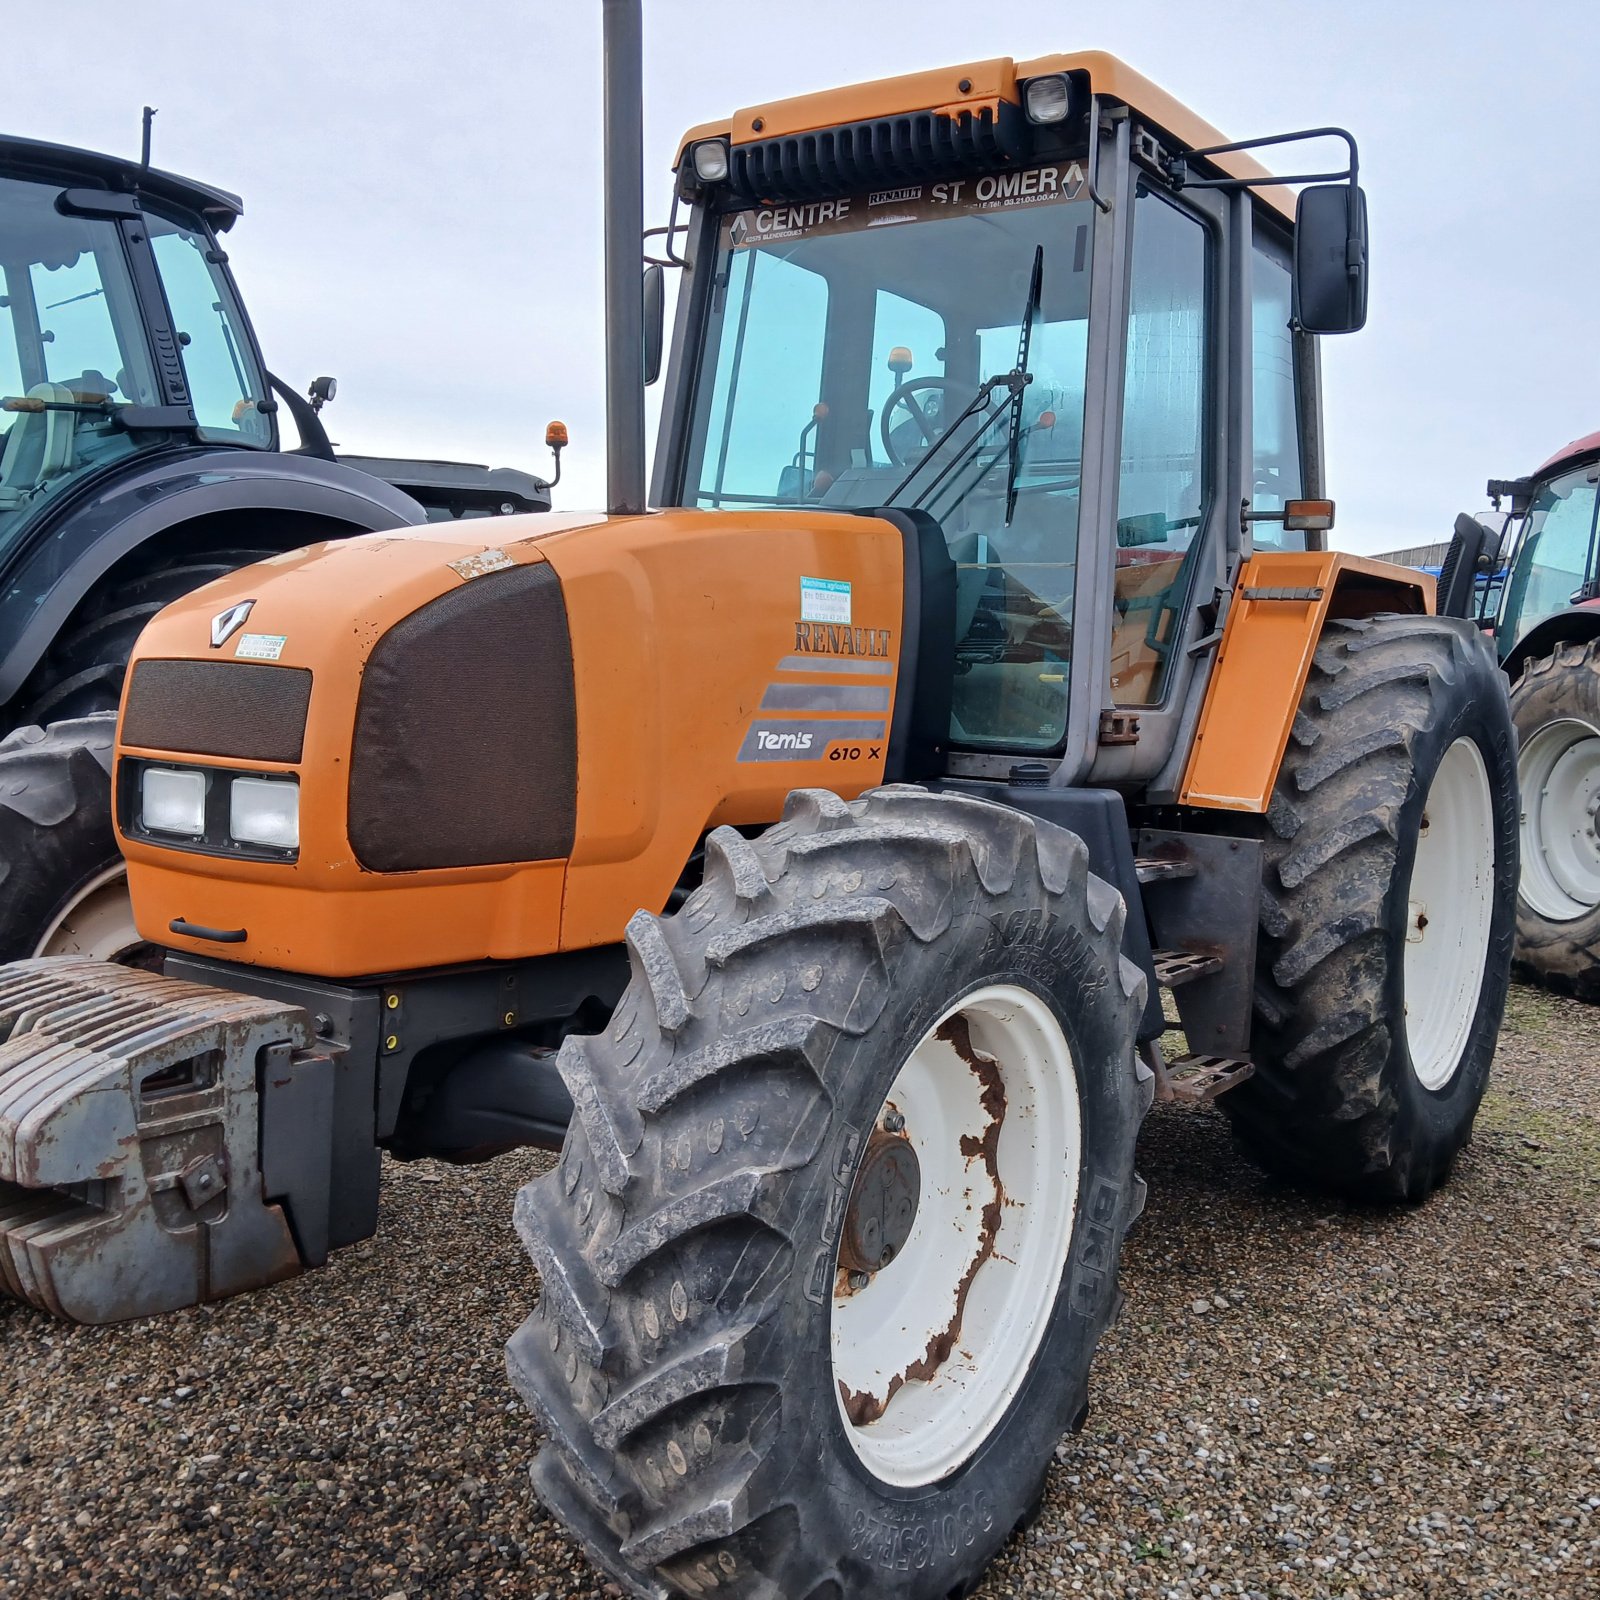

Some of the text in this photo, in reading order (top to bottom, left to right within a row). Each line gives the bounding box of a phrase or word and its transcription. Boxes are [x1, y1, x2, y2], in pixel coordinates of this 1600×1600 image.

[756, 199, 851, 233] CENTRE
[870, 188, 921, 204] RENAULT
[931, 181, 965, 204] ST
[975, 167, 1057, 201] OMER
[794, 622, 891, 657] RENAULT
[757, 731, 813, 749] Temis
[829, 747, 861, 761] 610
[1072, 1178, 1120, 1315] BKT
